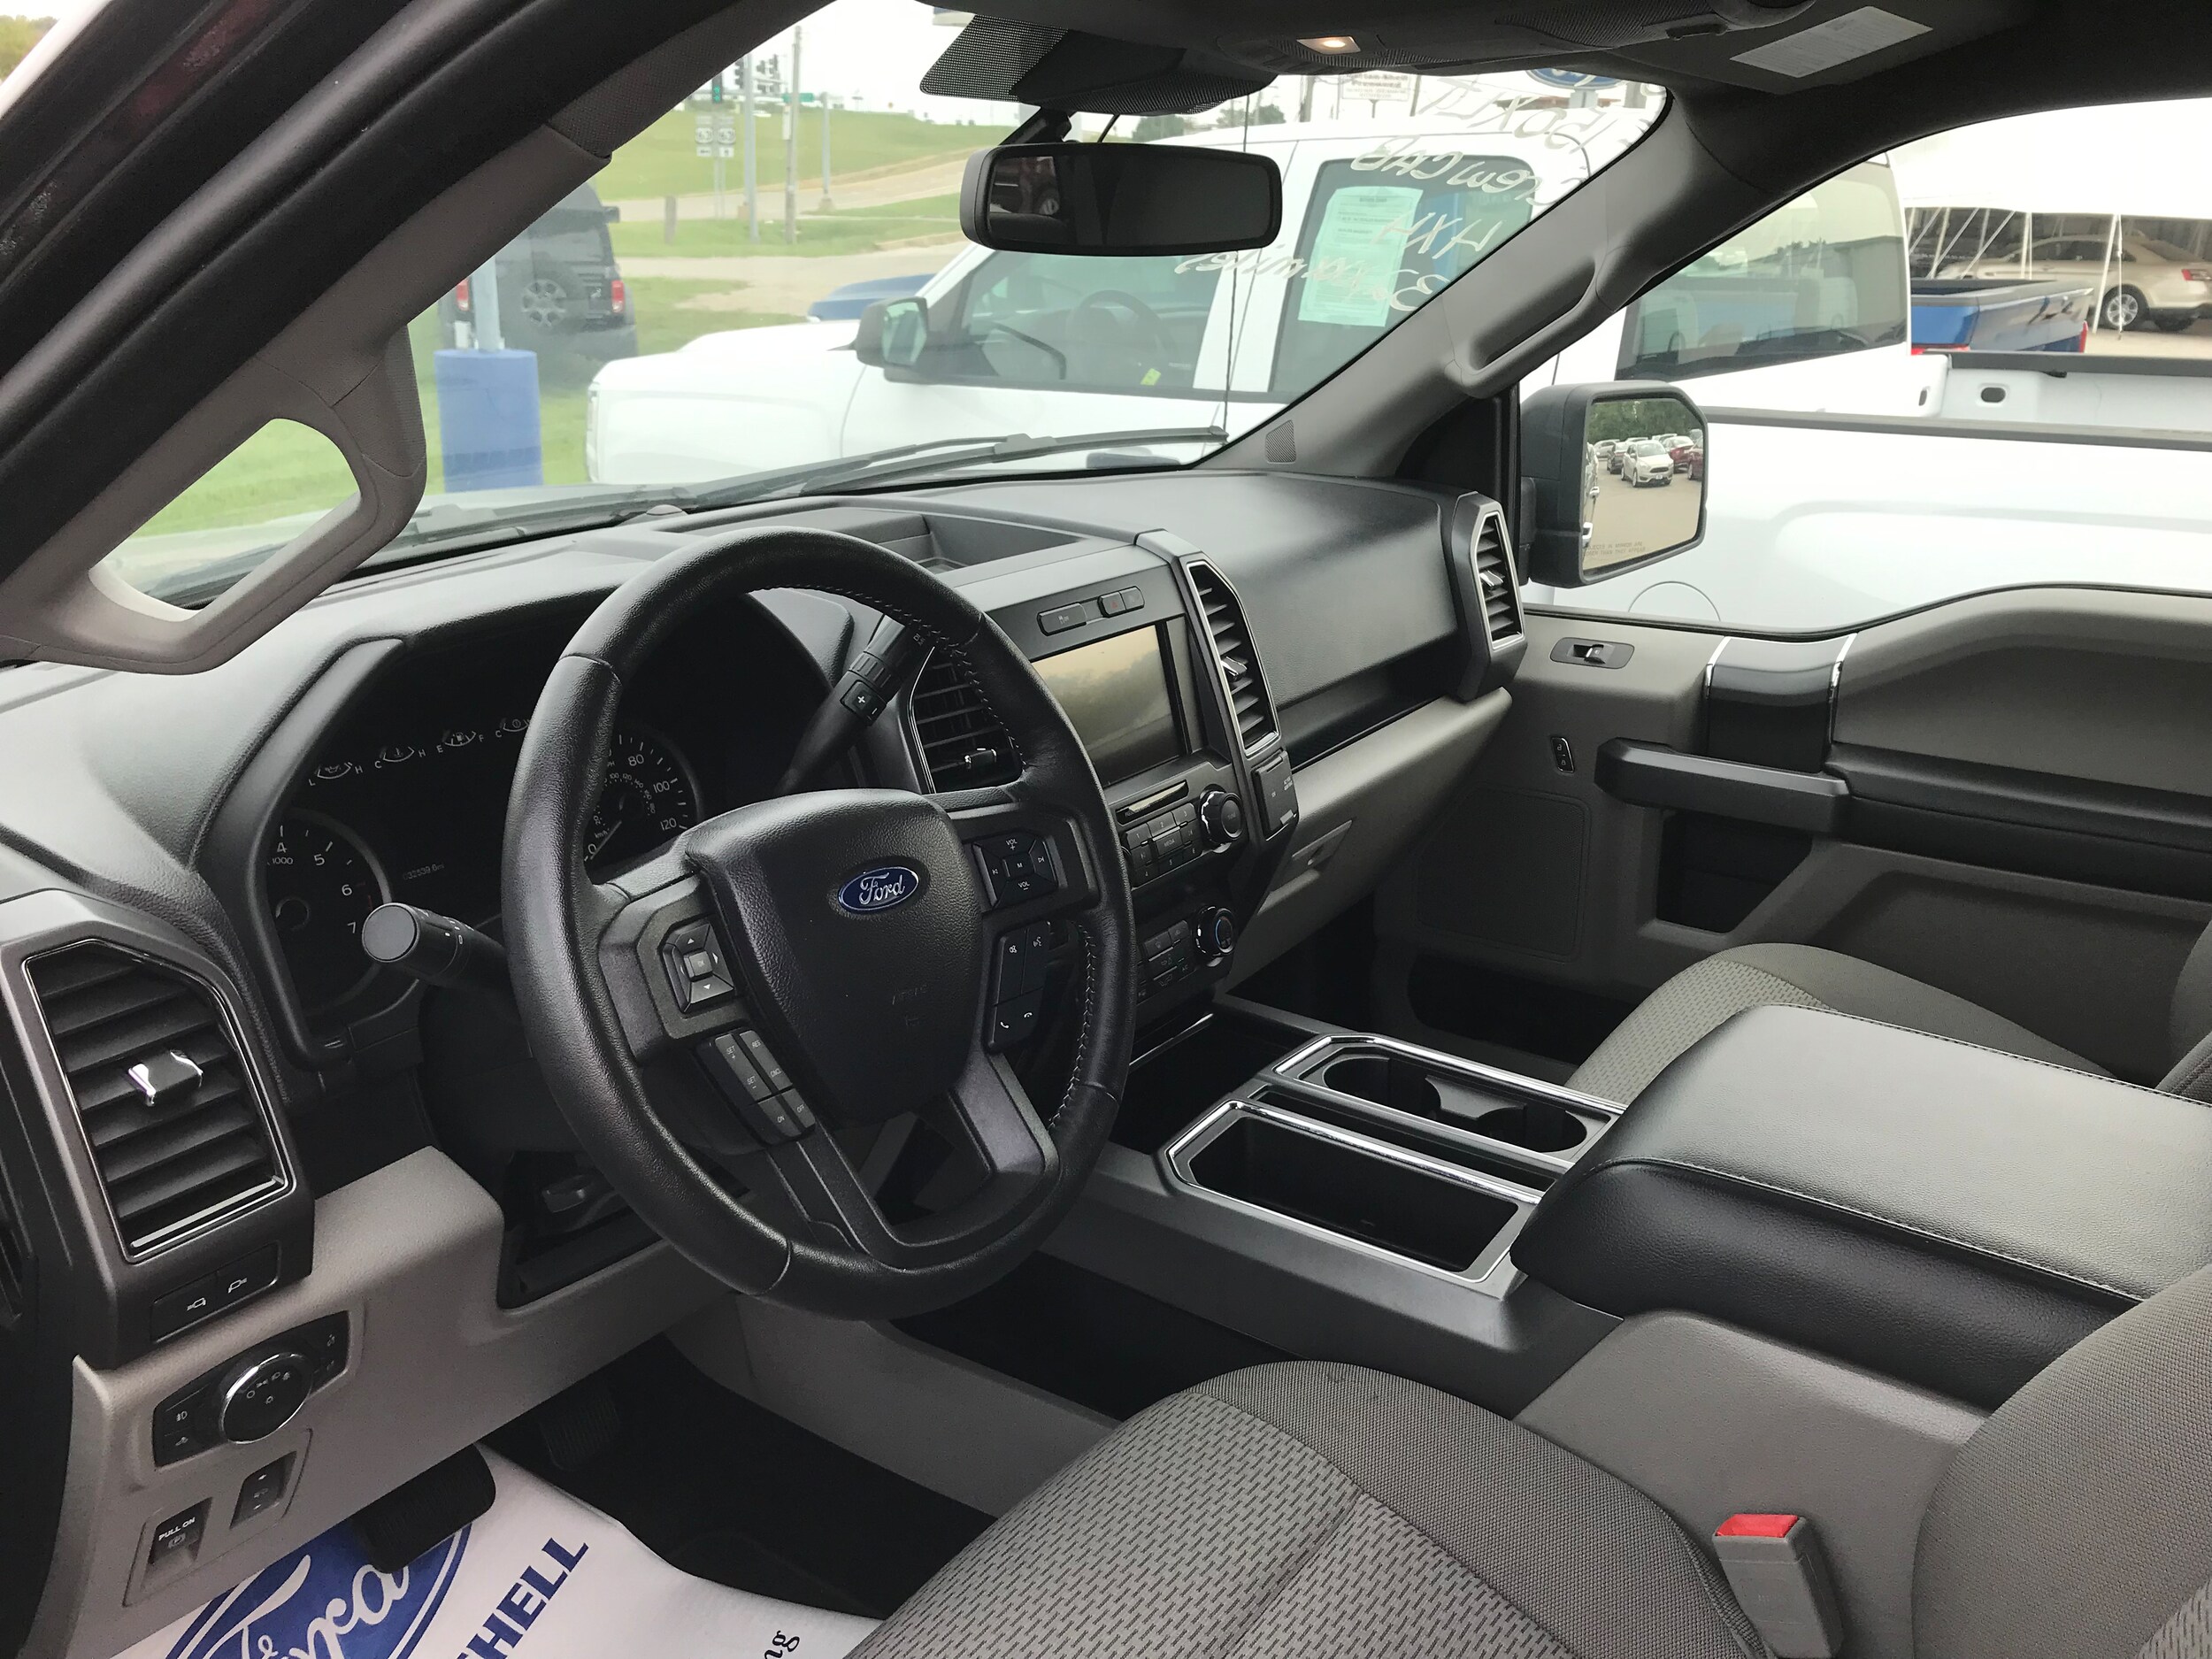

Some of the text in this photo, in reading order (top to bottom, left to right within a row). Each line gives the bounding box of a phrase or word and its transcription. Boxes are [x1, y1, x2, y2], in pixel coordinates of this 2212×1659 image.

[627, 754, 644, 766] 80
[653, 780, 670, 794] 100
[660, 818, 677, 831] 120
[276, 841, 288, 853] 4
[313, 854, 325, 865] 5
[342, 884, 352, 895] 6
[858, 872, 906, 905] Ford
[347, 921, 357, 933] 7
[158, 1517, 196, 1541] PULL ON
[457, 1537, 589, 1659] HELL
